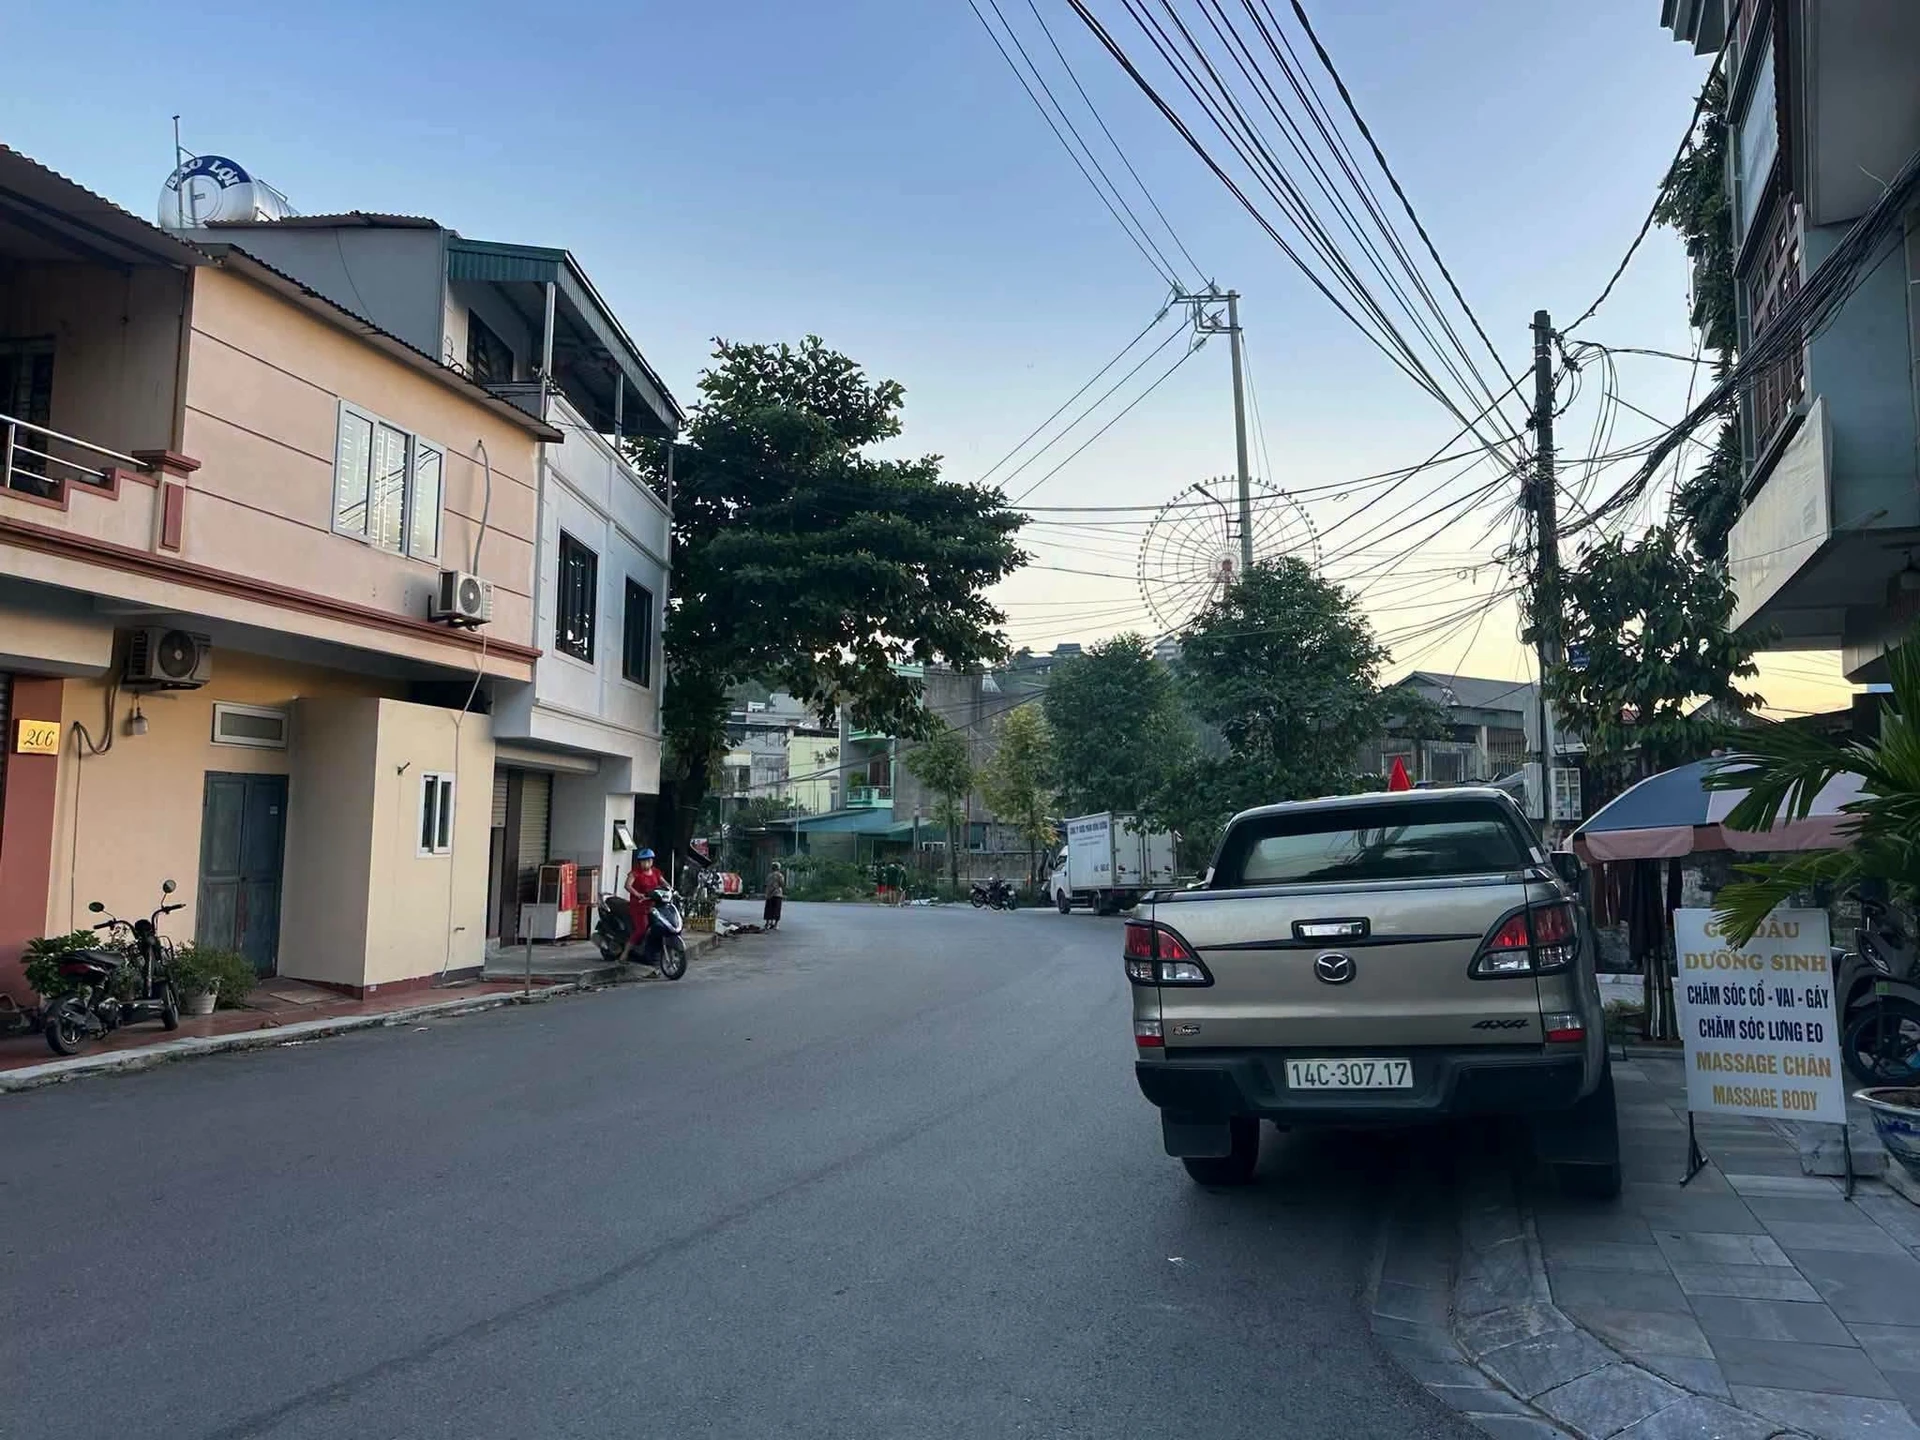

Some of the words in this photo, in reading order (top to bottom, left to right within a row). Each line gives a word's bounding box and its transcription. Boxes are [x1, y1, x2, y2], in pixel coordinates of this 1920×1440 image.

[23, 728, 55, 747] 206
[1684, 949, 1764, 971] DƯỠNG
[1771, 953, 1827, 972] SINH
[1687, 982, 1720, 1005] CHĂM
[1723, 982, 1746, 1006] SÓC
[1749, 979, 1765, 1006] CỔ
[1776, 987, 1795, 1008] VAI
[1806, 985, 1829, 1009] GÁY
[1699, 1015, 1735, 1039] CHĂM
[1739, 1016, 1765, 1040] SÓC
[1768, 1020, 1803, 1042] LƯNG
[1807, 1023, 1824, 1043] EO
[1292, 1062, 1407, 1087] 14C-307.17
[1696, 1051, 1778, 1075] MASSAGE
[1783, 1054, 1832, 1078] CHÂN
[1712, 1085, 1778, 1108] MASSAGE
[1782, 1090, 1818, 1111] BODY
